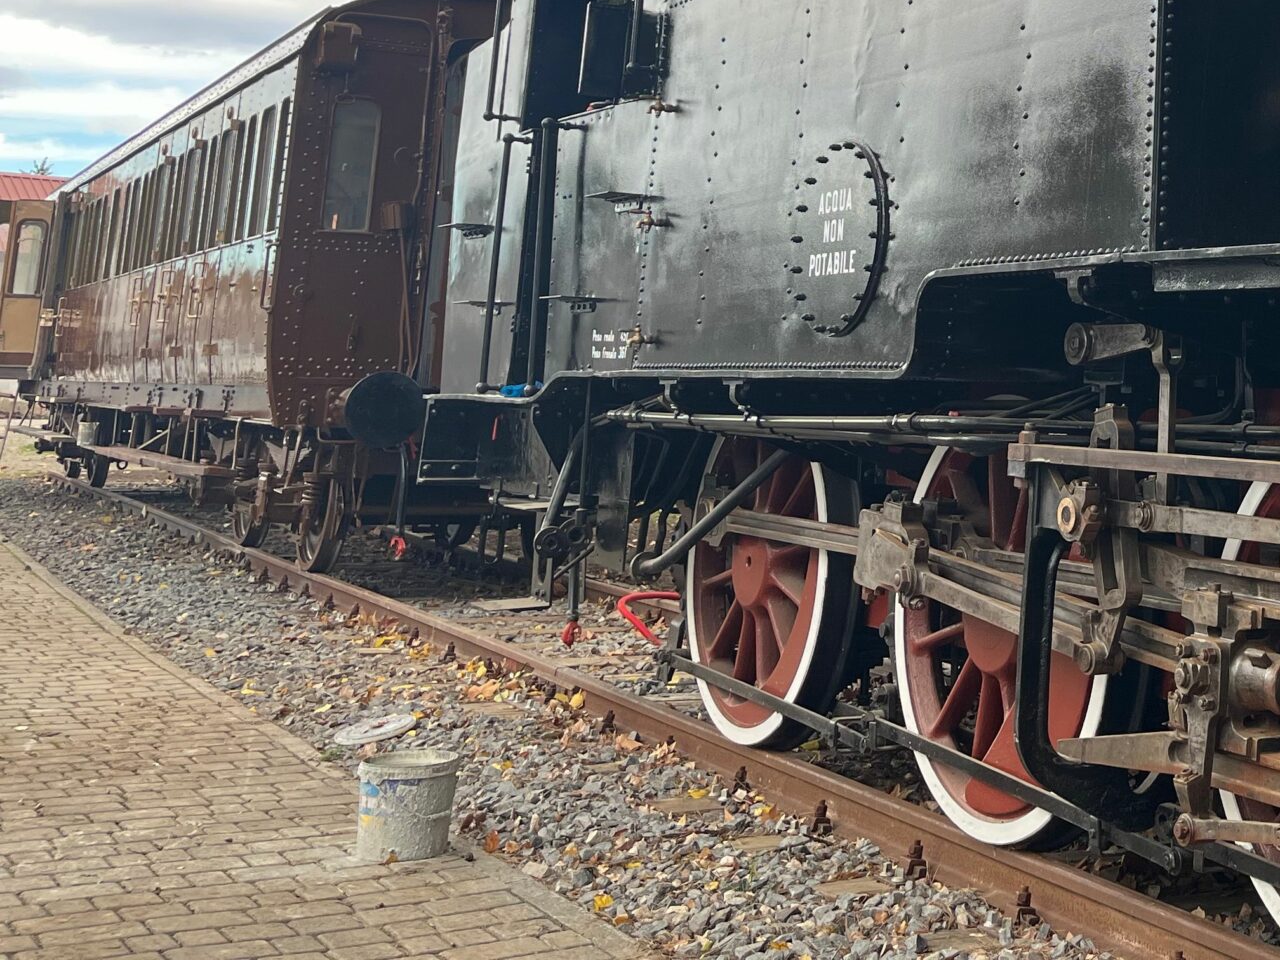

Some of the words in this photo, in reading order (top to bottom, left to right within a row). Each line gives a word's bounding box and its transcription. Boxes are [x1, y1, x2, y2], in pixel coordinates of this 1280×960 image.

[818, 188, 852, 215] ACQUA
[823, 218, 844, 243] NON
[808, 250, 857, 277] POTABILE
